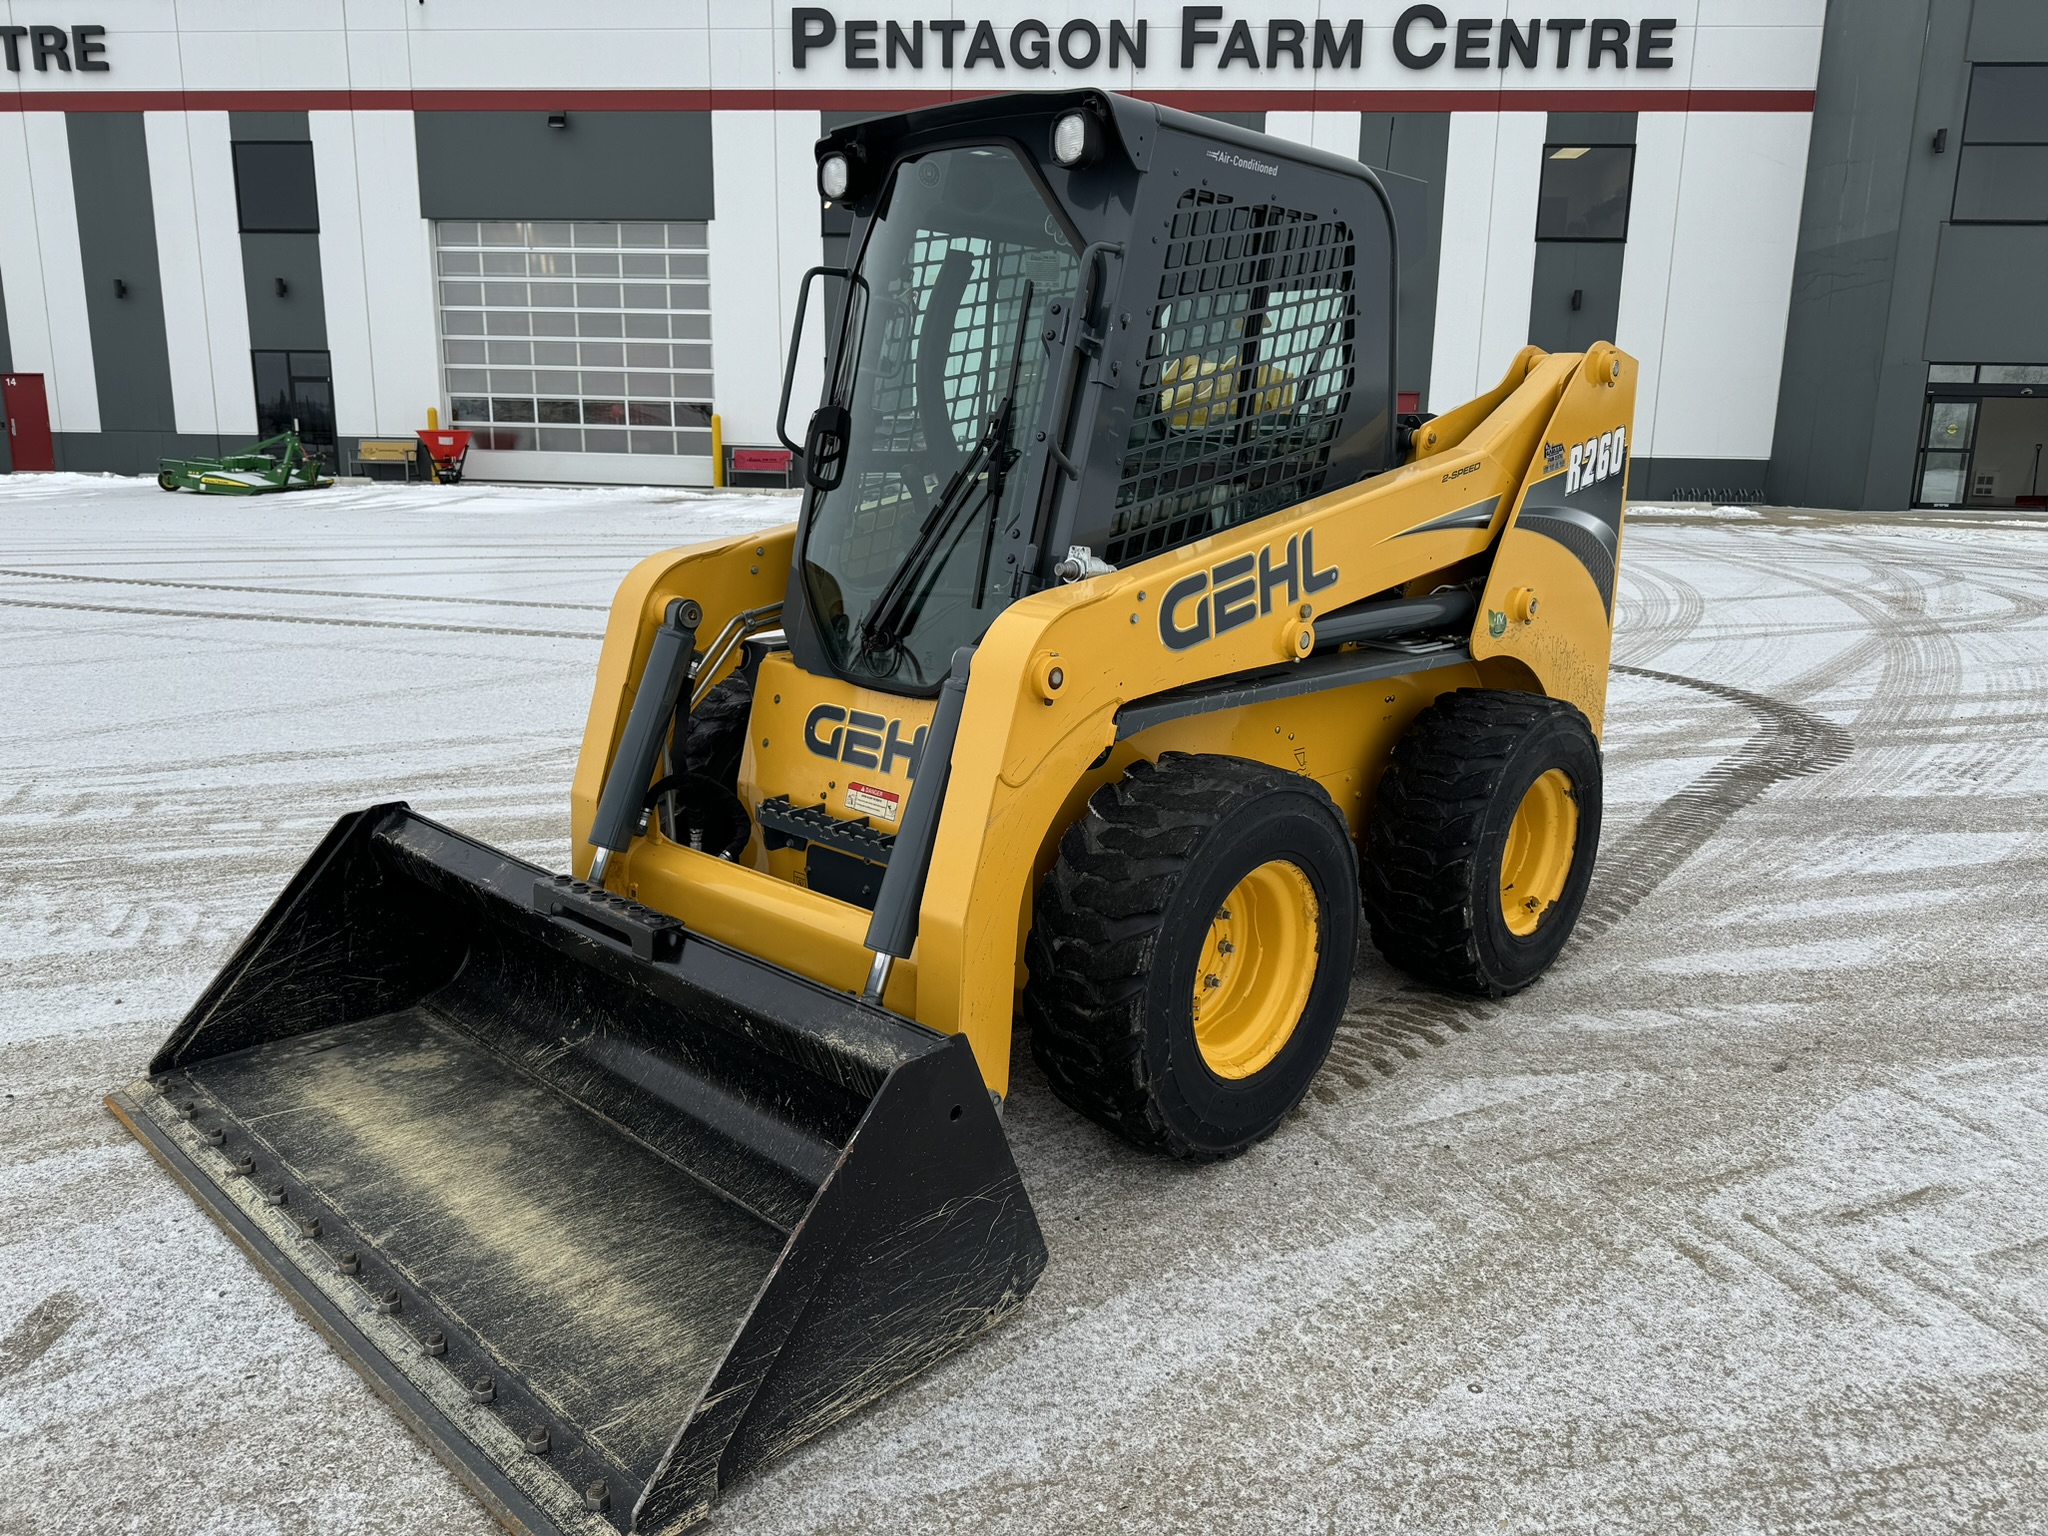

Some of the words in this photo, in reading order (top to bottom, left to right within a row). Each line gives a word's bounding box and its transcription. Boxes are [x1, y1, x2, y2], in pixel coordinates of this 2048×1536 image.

[0, 24, 110, 72] TRE
[791, 7, 1148, 70] PENTAGON
[1180, 5, 1364, 69] FARM
[1392, 3, 1678, 69] CENTRE
[1218, 151, 1279, 176] Air-Conditioned
[5, 377, 17, 387] 14
[1441, 461, 1482, 484] 2-SPEED
[1564, 424, 1627, 497] R260
[1157, 527, 1340, 652] GEHL
[865, 786, 883, 797] DANGER
